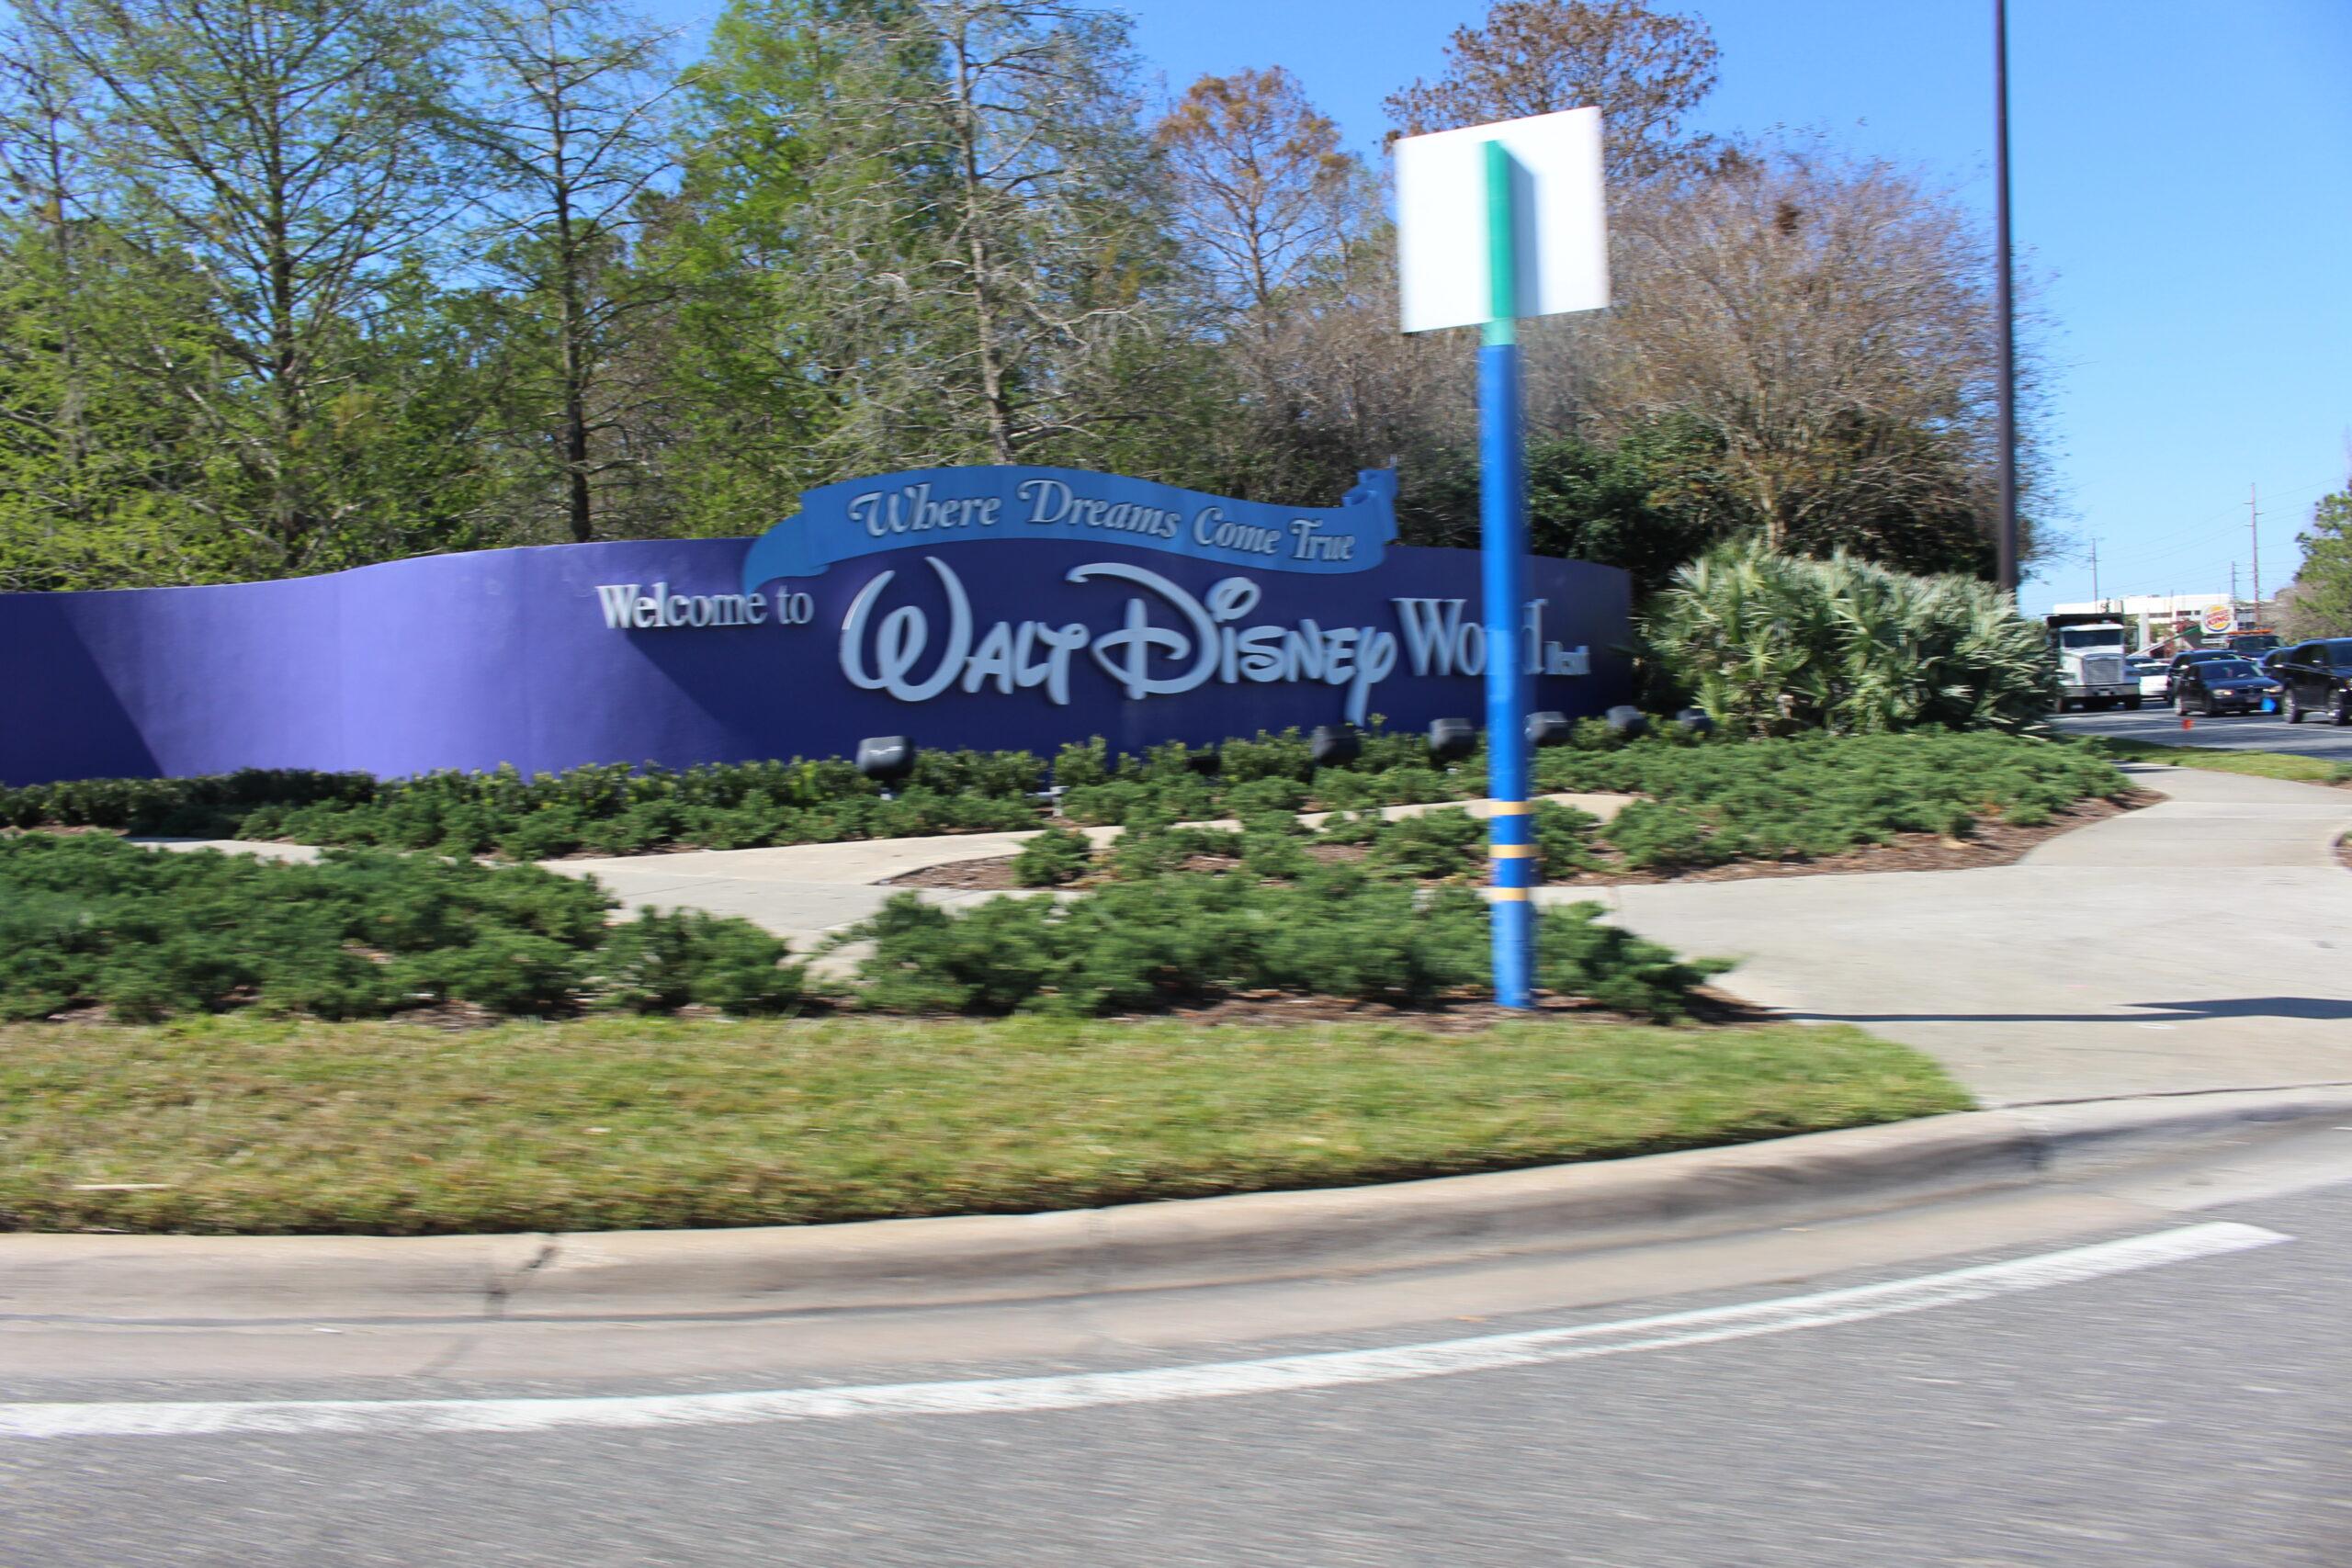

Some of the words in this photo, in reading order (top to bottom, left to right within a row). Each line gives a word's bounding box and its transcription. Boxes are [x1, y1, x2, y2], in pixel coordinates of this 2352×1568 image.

[848, 482, 1001, 537] Where
[1018, 479, 1182, 538] Dreams
[1193, 506, 1282, 555] Come
[1289, 517, 1356, 561] True
[595, 581, 768, 629] Welcome
[775, 584, 815, 625] to
